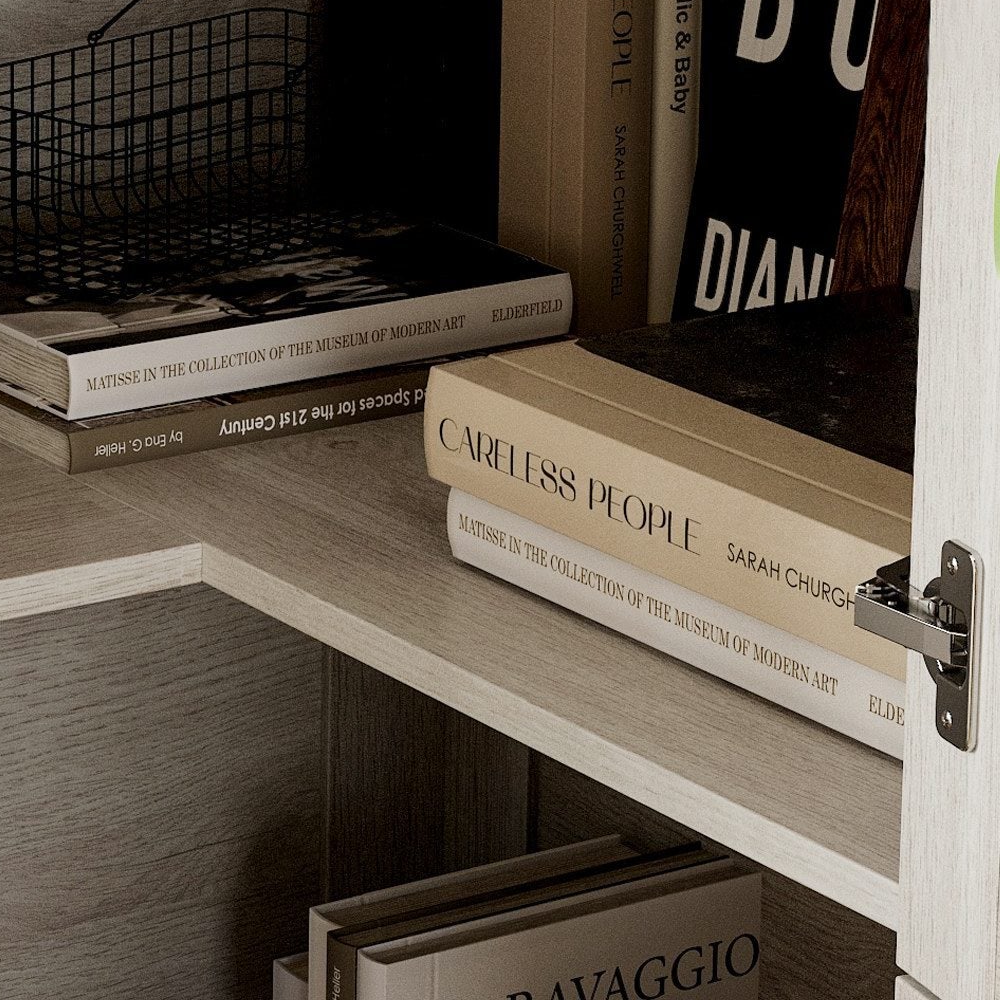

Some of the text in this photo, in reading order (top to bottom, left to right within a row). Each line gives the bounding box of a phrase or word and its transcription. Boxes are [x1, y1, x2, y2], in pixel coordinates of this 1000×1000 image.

[675, 30, 692, 50] &
[670, 56, 692, 114] Baby
[614, 125, 627, 182] SARAH
[694, 217, 836, 314] DIAN
[86, 298, 564, 392] MATISSE IN THE COLLECTION OF THE MUSEUM OF MODERN ART ELDERFIELD
[337, 400, 356, 416] for
[359, 388, 410, 411] Spaces
[279, 408, 307, 429] 21st
[311, 404, 334, 420] the
[219, 414, 276, 437] Century
[94, 441, 126, 457] Heller
[128, 438, 143, 452] G.
[145, 433, 166, 447] Ena
[168, 431, 183, 444] by
[439, 417, 576, 502] CARELESS
[589, 477, 702, 556] PEOPLE
[727, 542, 781, 581] SARAH
[458, 513, 905, 726] MATISSE IN THE COLLECTION OF THE MUSEUM OF MODERN ART ELDE
[506, 933, 761, 1000] VAGGIO
[331, 965, 342, 1000] Heller
